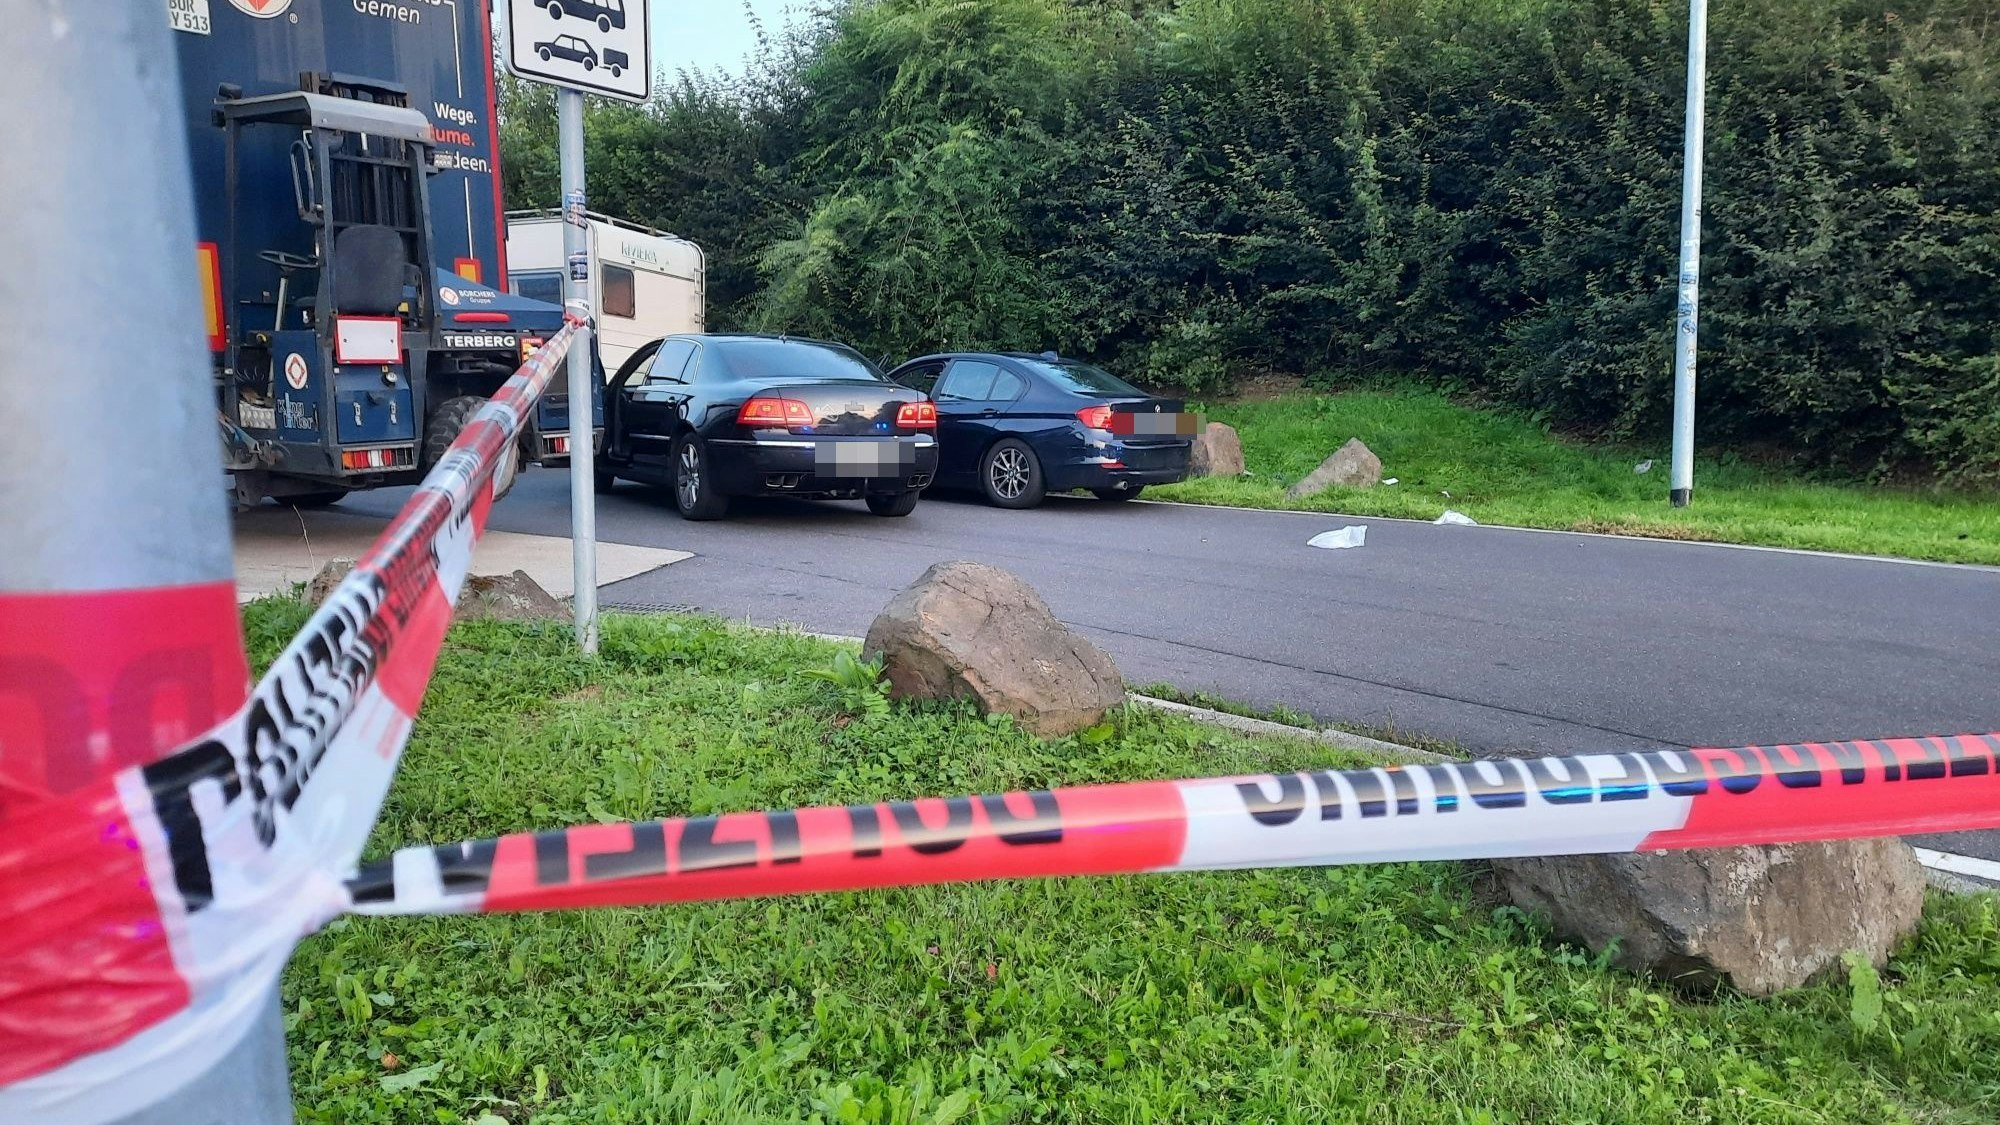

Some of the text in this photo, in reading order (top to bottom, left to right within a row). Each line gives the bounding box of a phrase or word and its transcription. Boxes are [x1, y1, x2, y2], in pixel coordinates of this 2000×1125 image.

[183, 13, 209, 31] 513
[353, 0, 420, 24] Gemen
[434, 101, 477, 126] Wege.
[430, 124, 476, 147] ume.
[446, 150, 492, 174] deen.
[458, 289, 496, 298] BORCHERS
[443, 335, 516, 348] TERBERG
